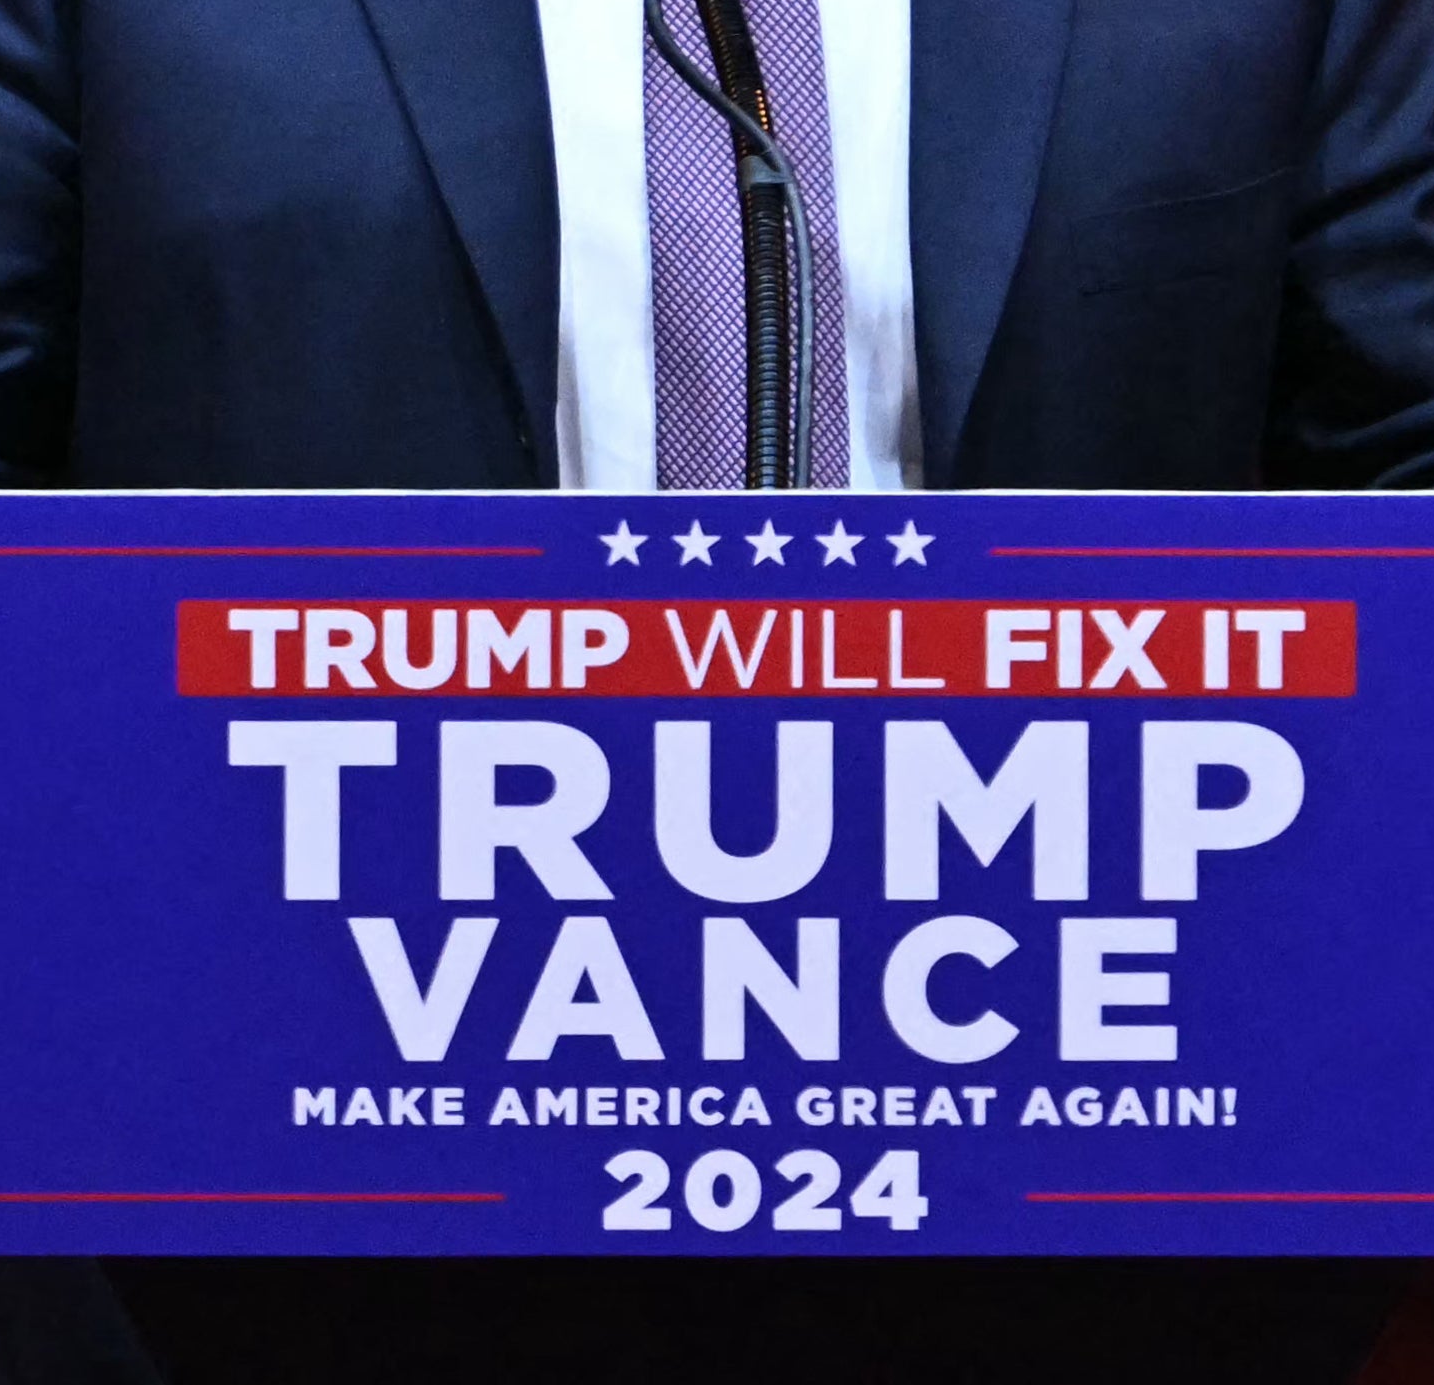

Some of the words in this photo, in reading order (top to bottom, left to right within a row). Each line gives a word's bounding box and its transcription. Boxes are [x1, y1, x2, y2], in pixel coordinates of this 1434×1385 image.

[227, 608, 630, 690] TRUMP
[664, 608, 946, 690] WILL
[985, 608, 1168, 690] FIX
[1202, 608, 1306, 690] IT
[227, 720, 1305, 904] TRUMP
[347, 915, 1178, 1064] VANCE
[293, 1086, 465, 1126] MAKE
[488, 1086, 772, 1126] AMERICA
[795, 1086, 997, 1126] GREAT
[1020, 1086, 1237, 1127] AGAIN!
[602, 1149, 929, 1232] 2024
